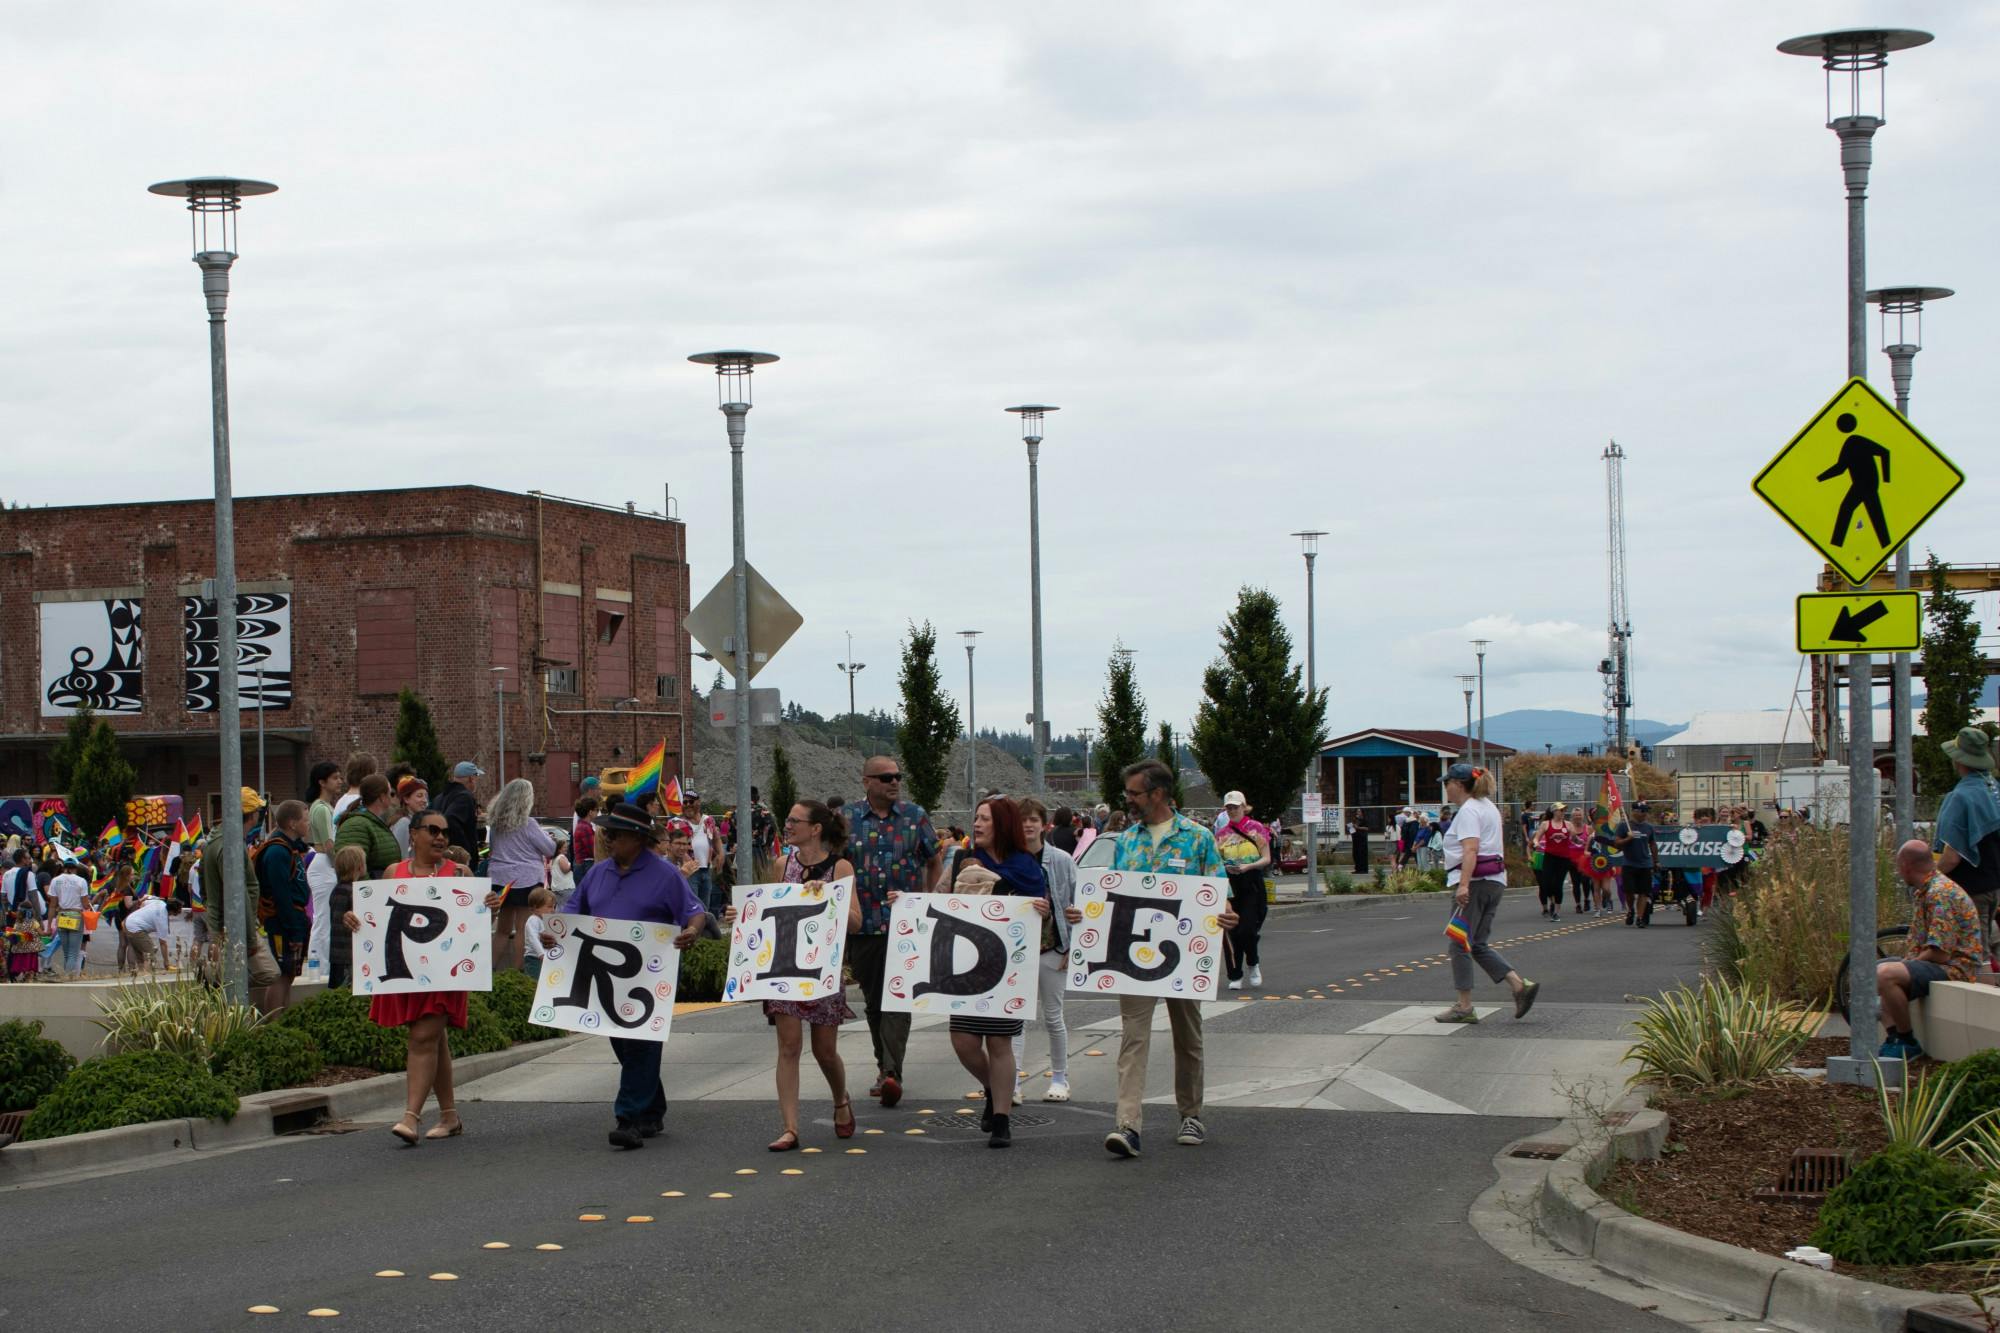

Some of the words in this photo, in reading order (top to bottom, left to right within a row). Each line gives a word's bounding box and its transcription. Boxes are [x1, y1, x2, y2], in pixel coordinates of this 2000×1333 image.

[378, 896, 449, 983] P
[553, 927, 655, 1029] R
[756, 900, 828, 981] I
[911, 905, 1008, 999] D
[1087, 891, 1182, 982] E
